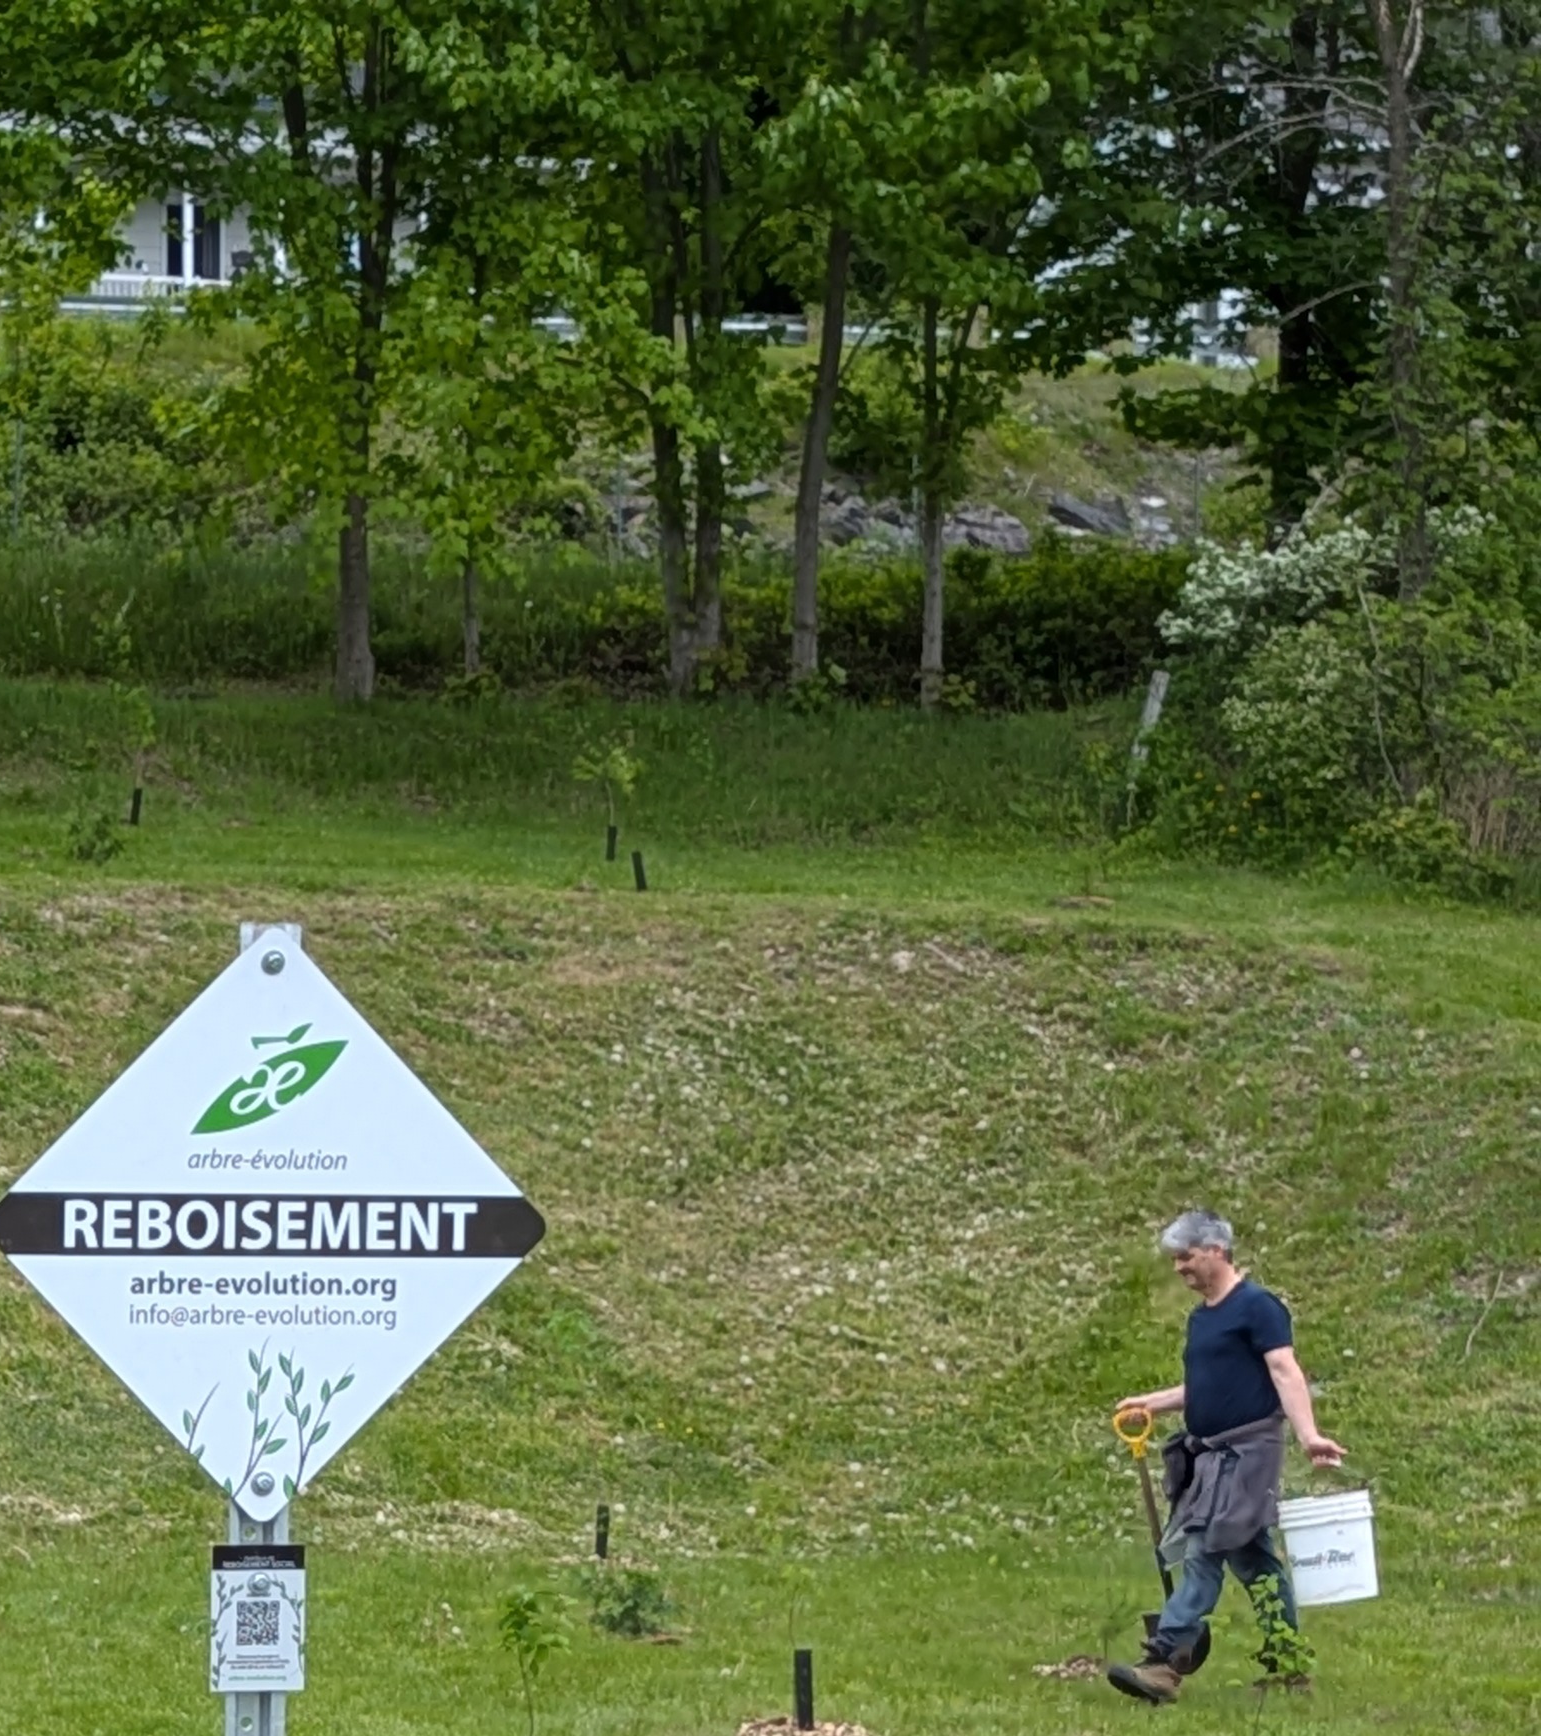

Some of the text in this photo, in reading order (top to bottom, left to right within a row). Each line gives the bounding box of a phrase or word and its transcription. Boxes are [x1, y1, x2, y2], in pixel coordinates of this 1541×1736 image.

[188, 1149, 347, 1169] arbre-évolution
[64, 1200, 477, 1250] REBOISEMENT
[130, 1271, 396, 1302] arbre-evolution.org
[130, 1304, 396, 1330] info@arbre-evolution.org
